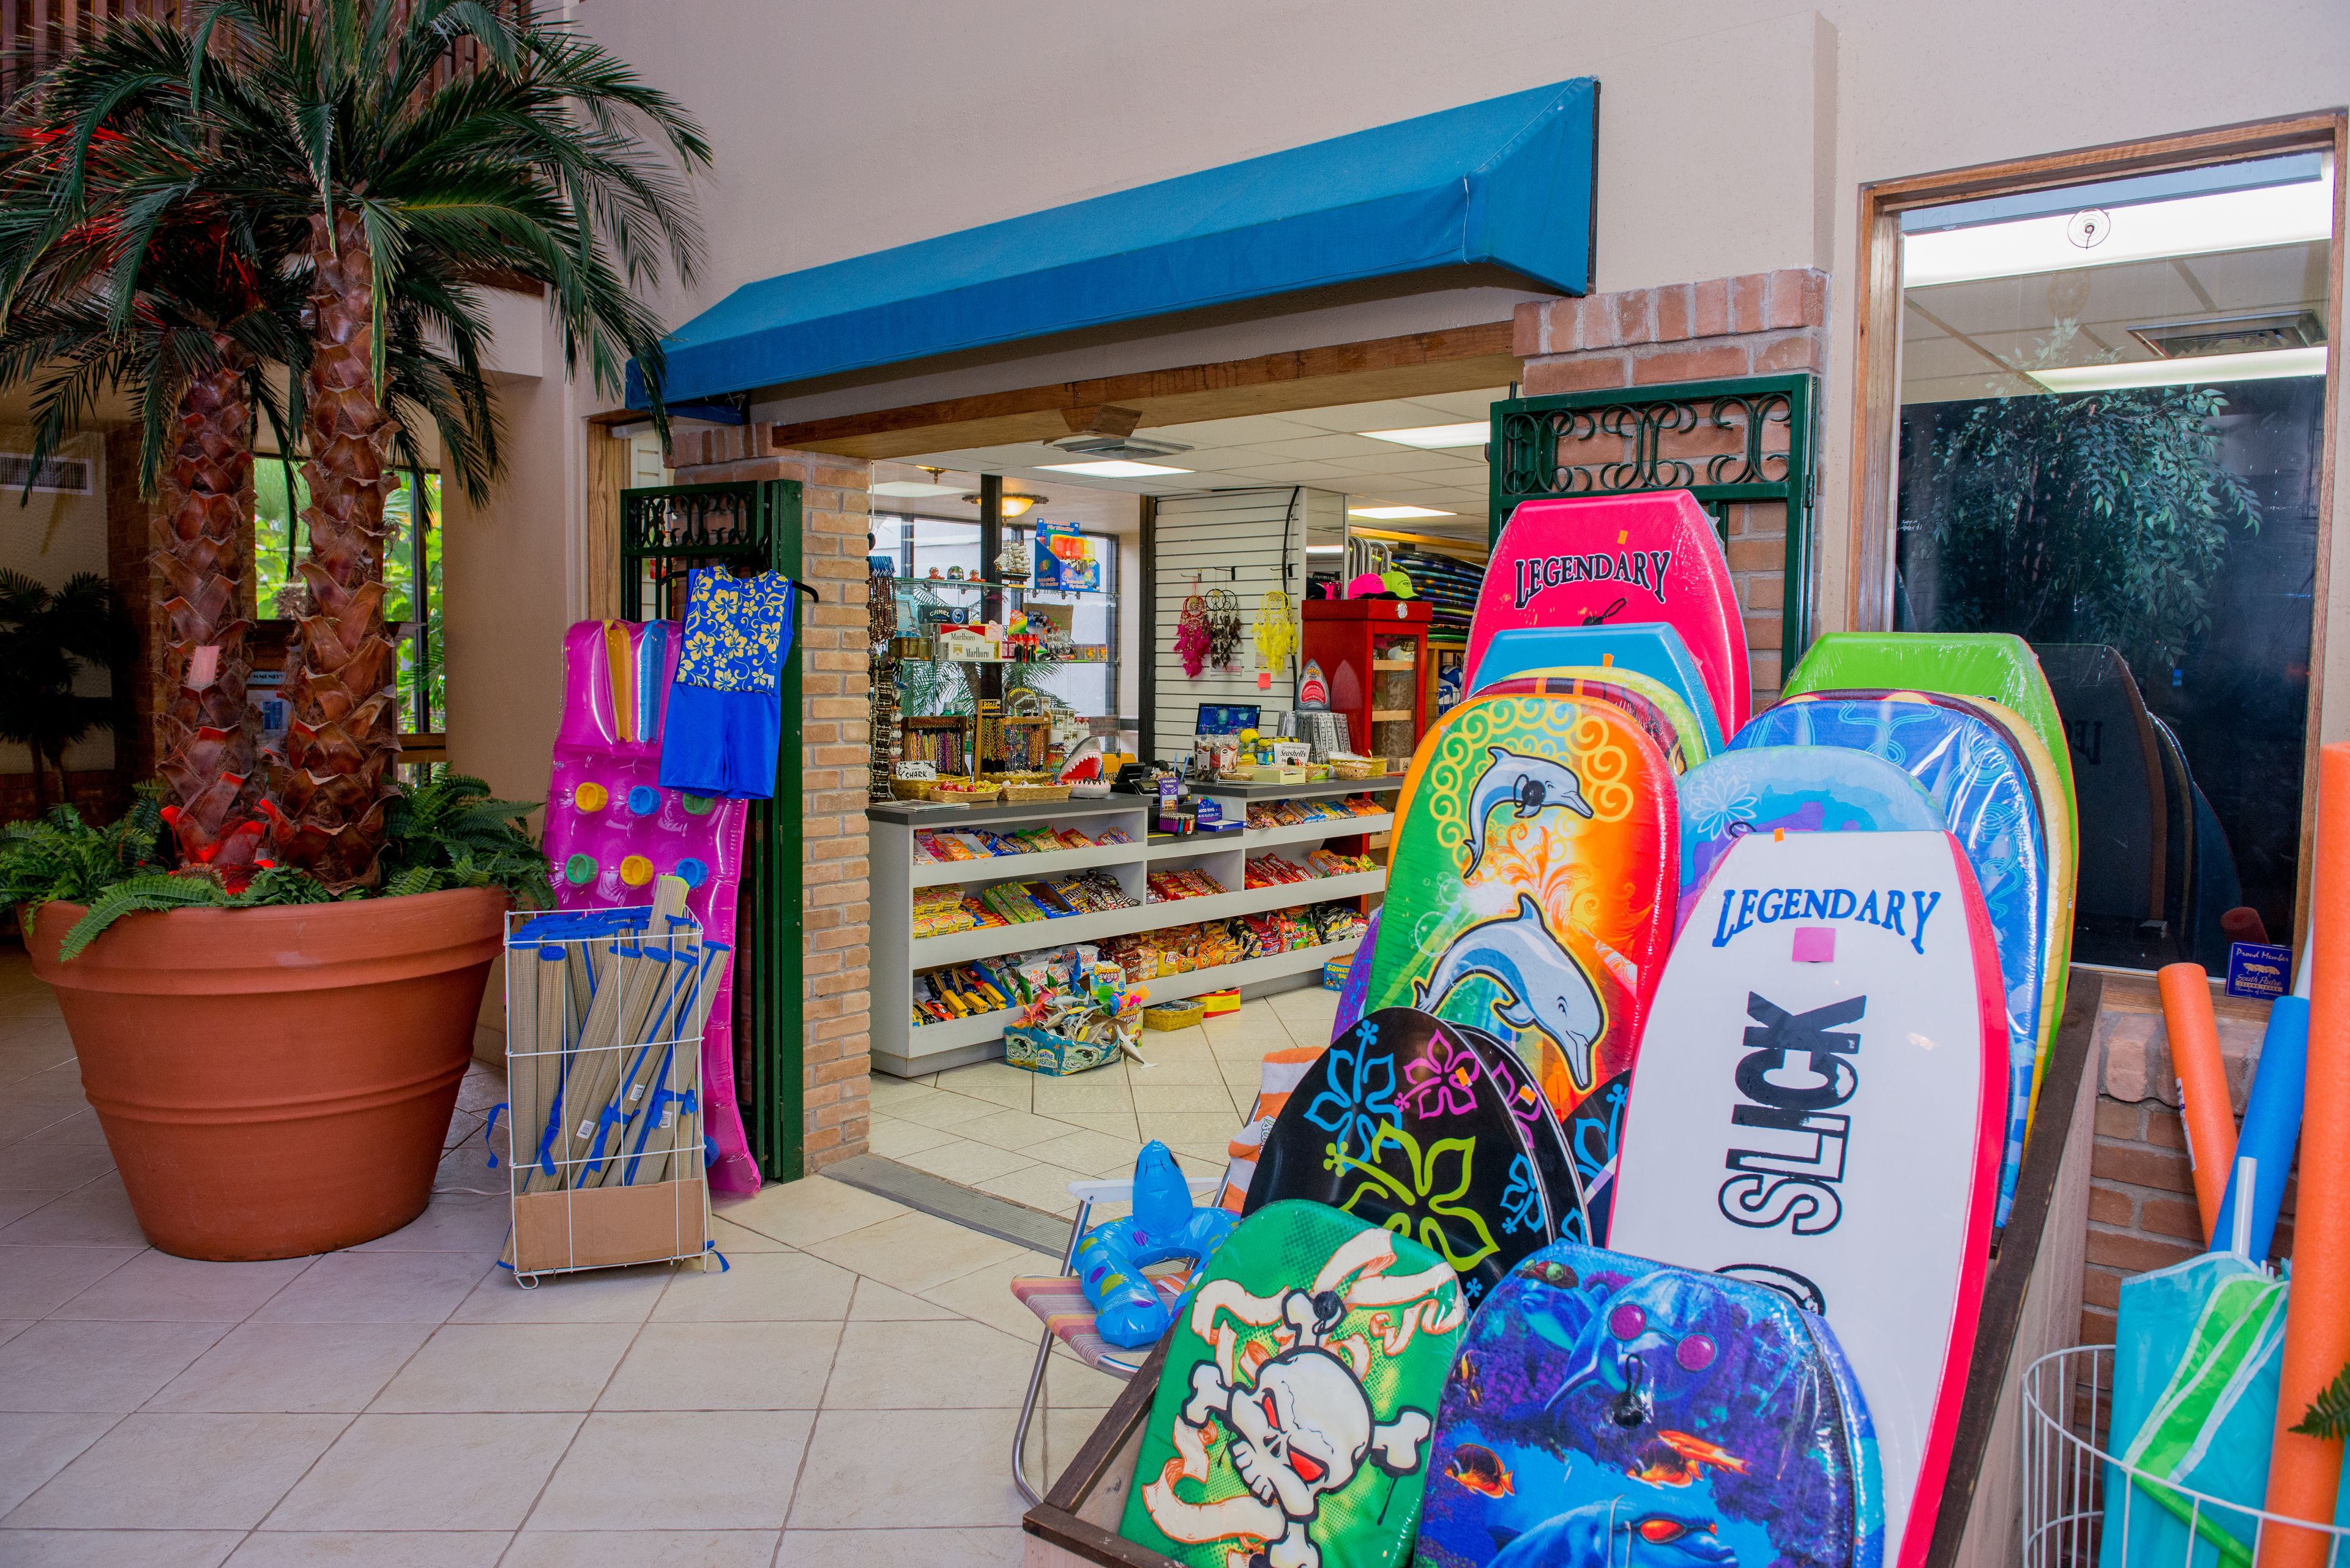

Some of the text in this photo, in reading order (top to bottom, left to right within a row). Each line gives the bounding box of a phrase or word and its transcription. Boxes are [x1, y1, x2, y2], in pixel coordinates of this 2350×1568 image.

[1515, 550, 1671, 610] LEGENDARY
[950, 633, 975, 641] Marlboro
[966, 646, 989, 659] Marlboro
[906, 771, 927, 779] SHARK
[1712, 889, 1941, 955] LEGENDARY
[2237, 947, 2289, 961] Proud Member
[1094, 964, 1121, 976] Bubble
[2237, 974, 2282, 986] South Padre
[1039, 1051, 1053, 1060] MARINE
[1037, 1059, 1056, 1067] CREATURE
[1718, 990, 1867, 1236] SLICK
